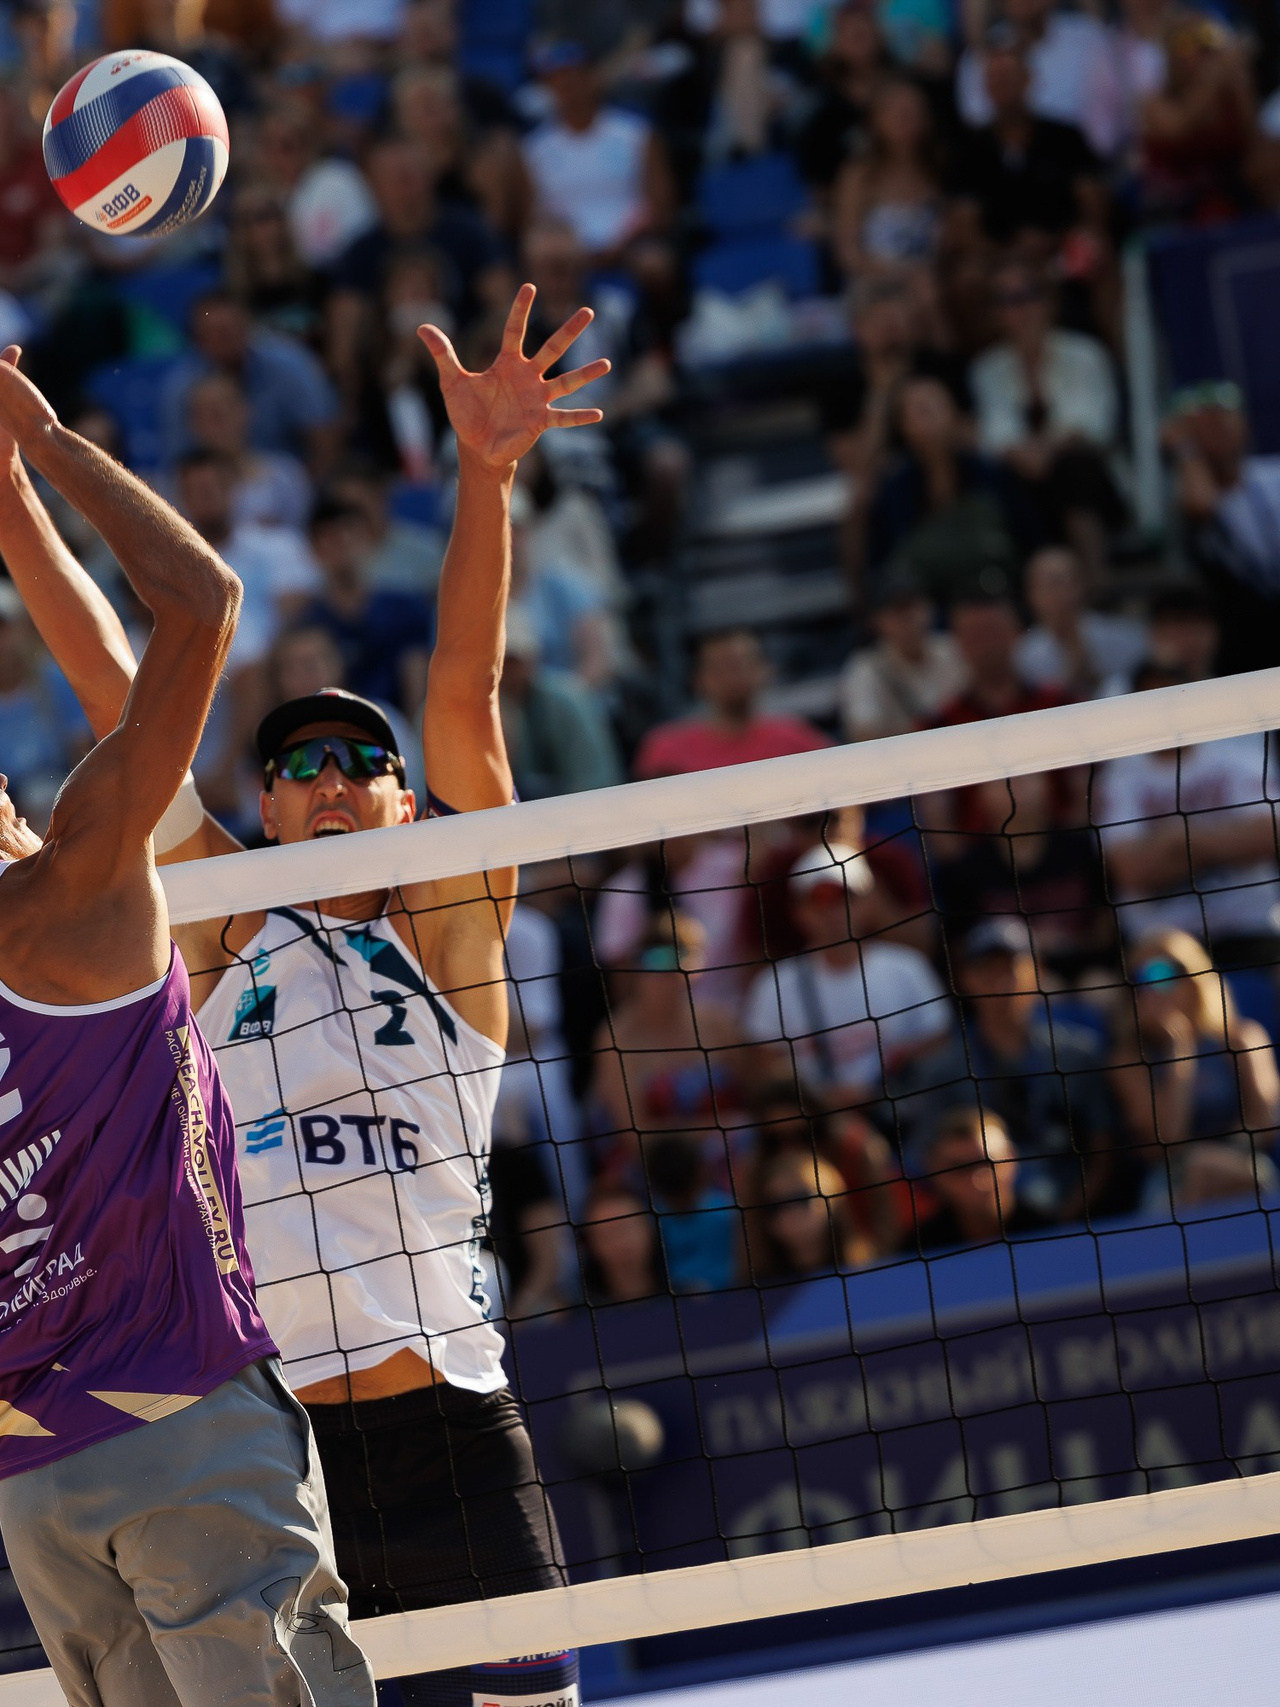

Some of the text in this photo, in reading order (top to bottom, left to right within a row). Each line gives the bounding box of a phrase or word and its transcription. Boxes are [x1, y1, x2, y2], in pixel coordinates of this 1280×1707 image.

[102, 183, 141, 218] ВФВ
[240, 1020, 272, 1036] ВФВ
[370, 989, 415, 1046] 2
[299, 1114, 421, 1174] ВТБ
